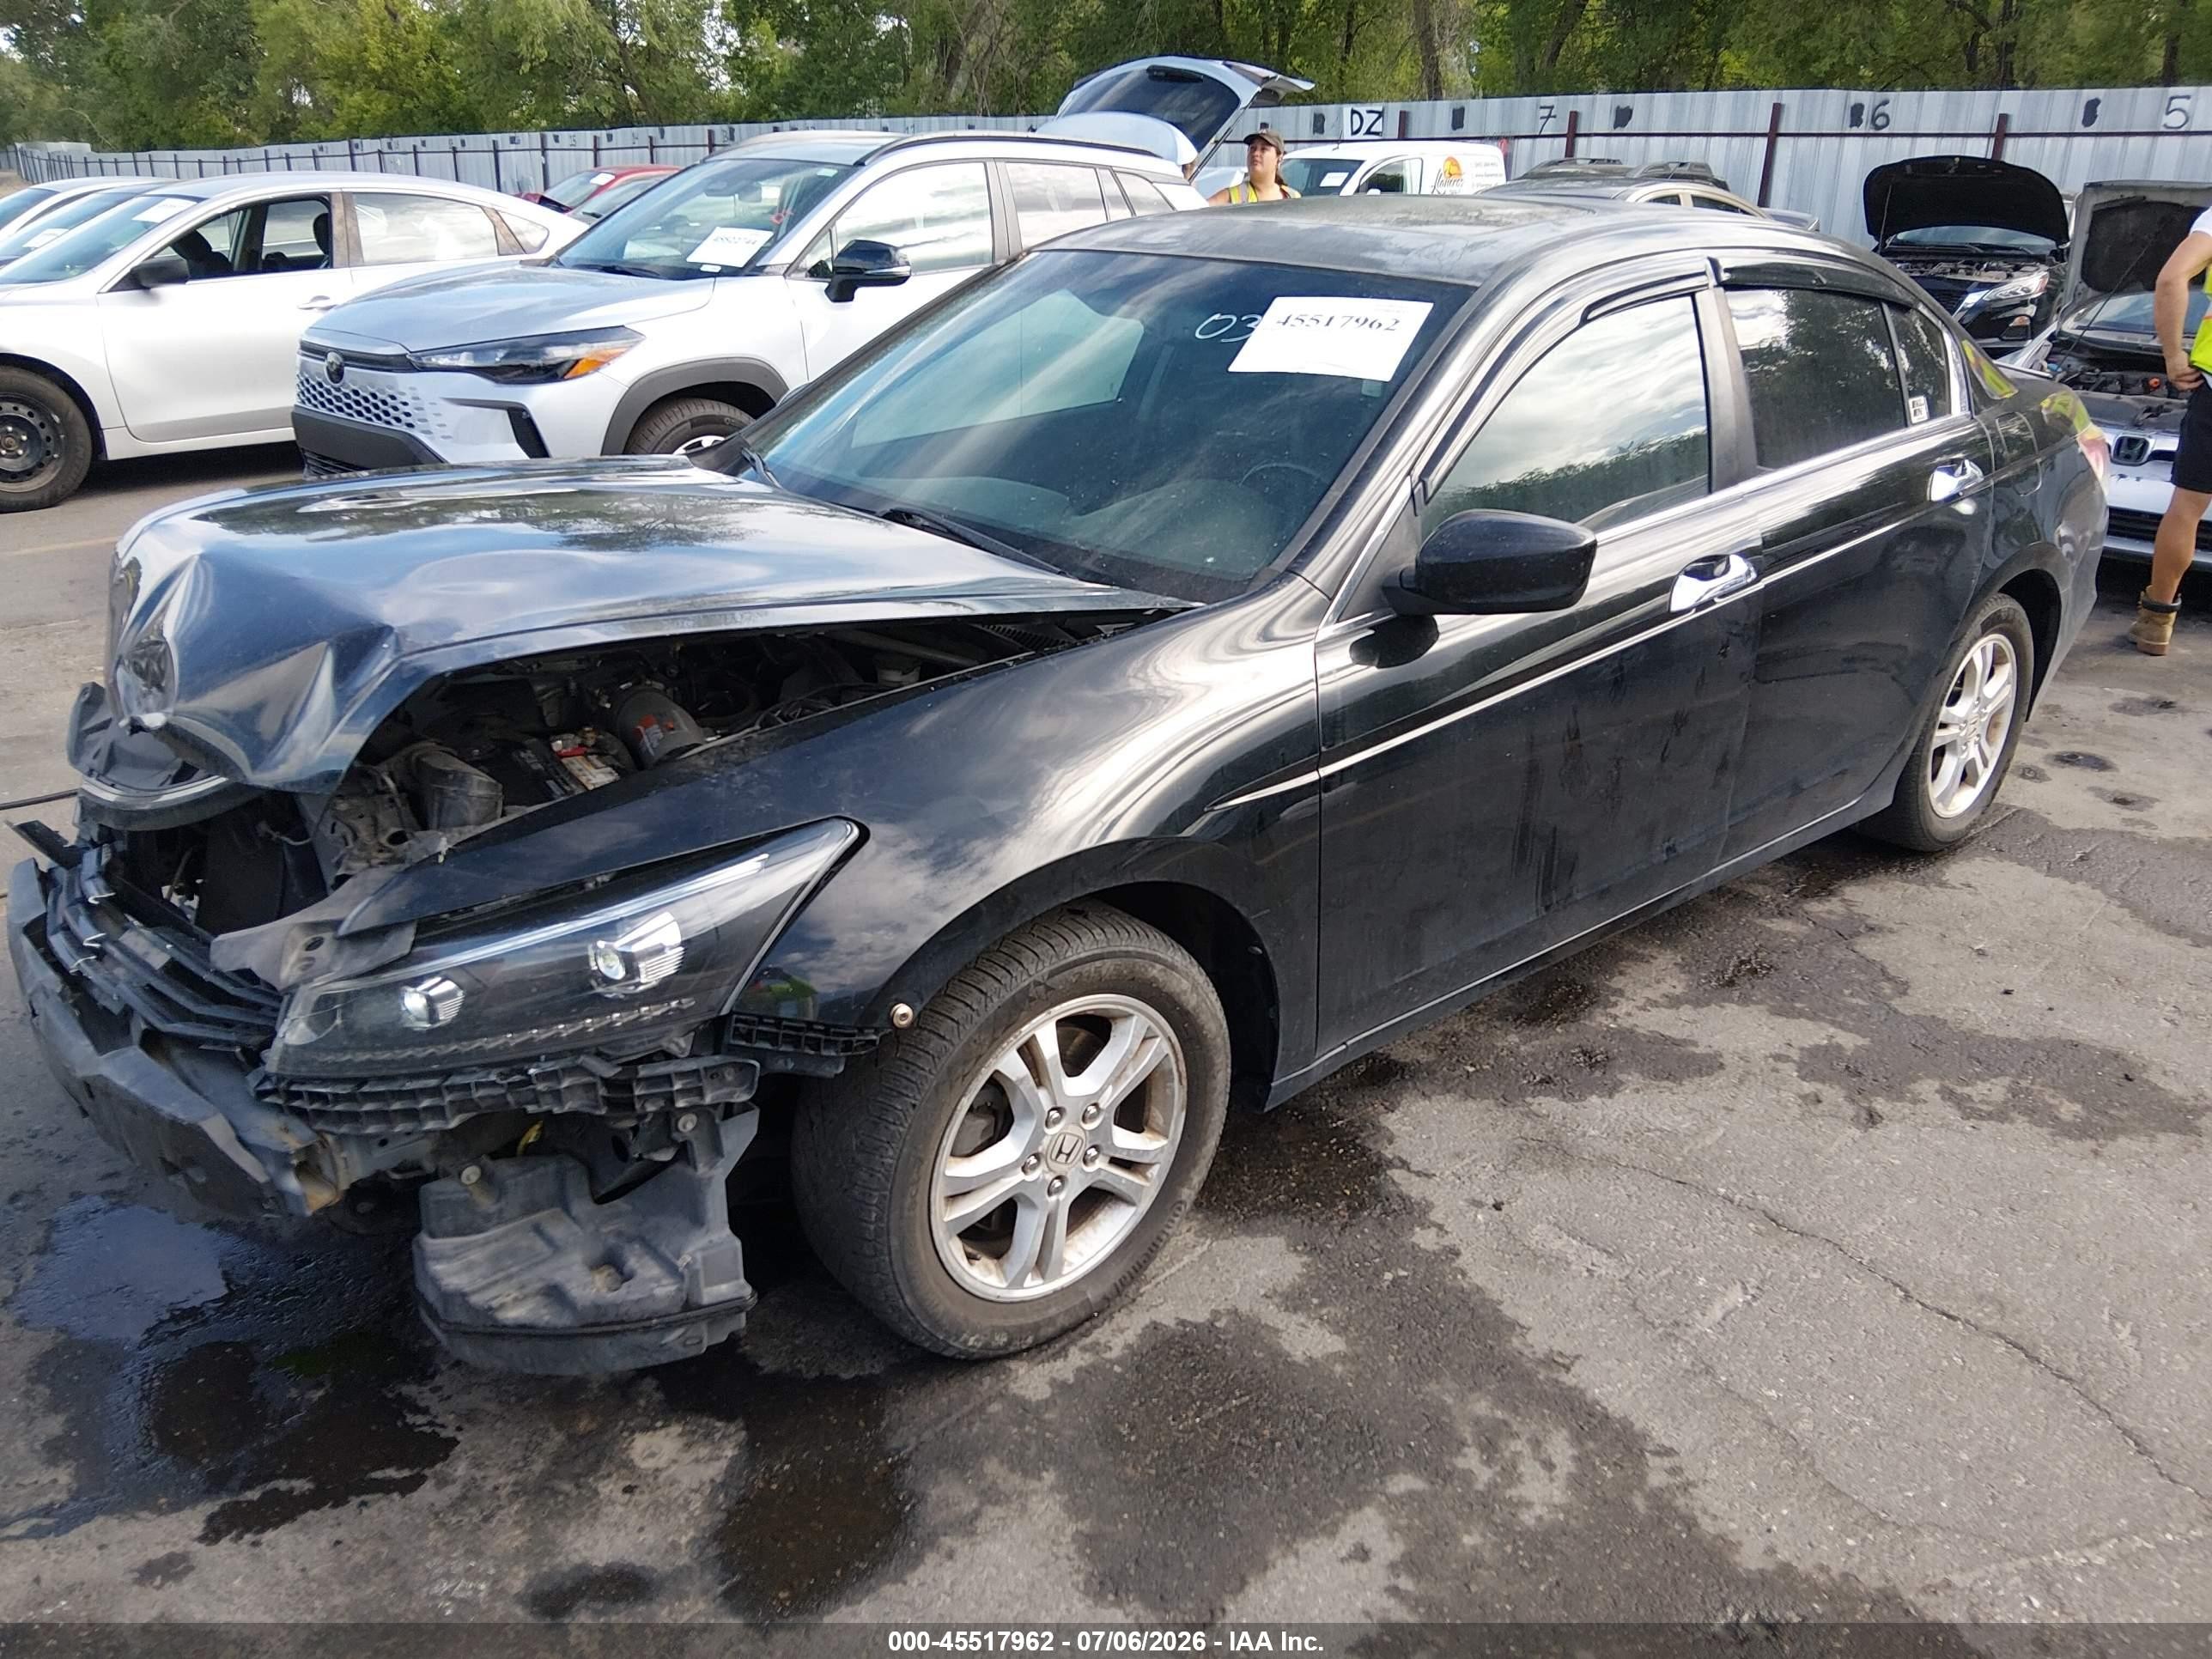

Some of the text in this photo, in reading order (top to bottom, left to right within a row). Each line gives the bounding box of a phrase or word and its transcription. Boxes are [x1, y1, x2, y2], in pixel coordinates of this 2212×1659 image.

[1351, 108, 1384, 136] DZ
[1539, 104, 1557, 136] 7
[1870, 99, 1890, 131] 6
[2163, 95, 2191, 130] 5
[1277, 313, 1401, 332] 45517962
